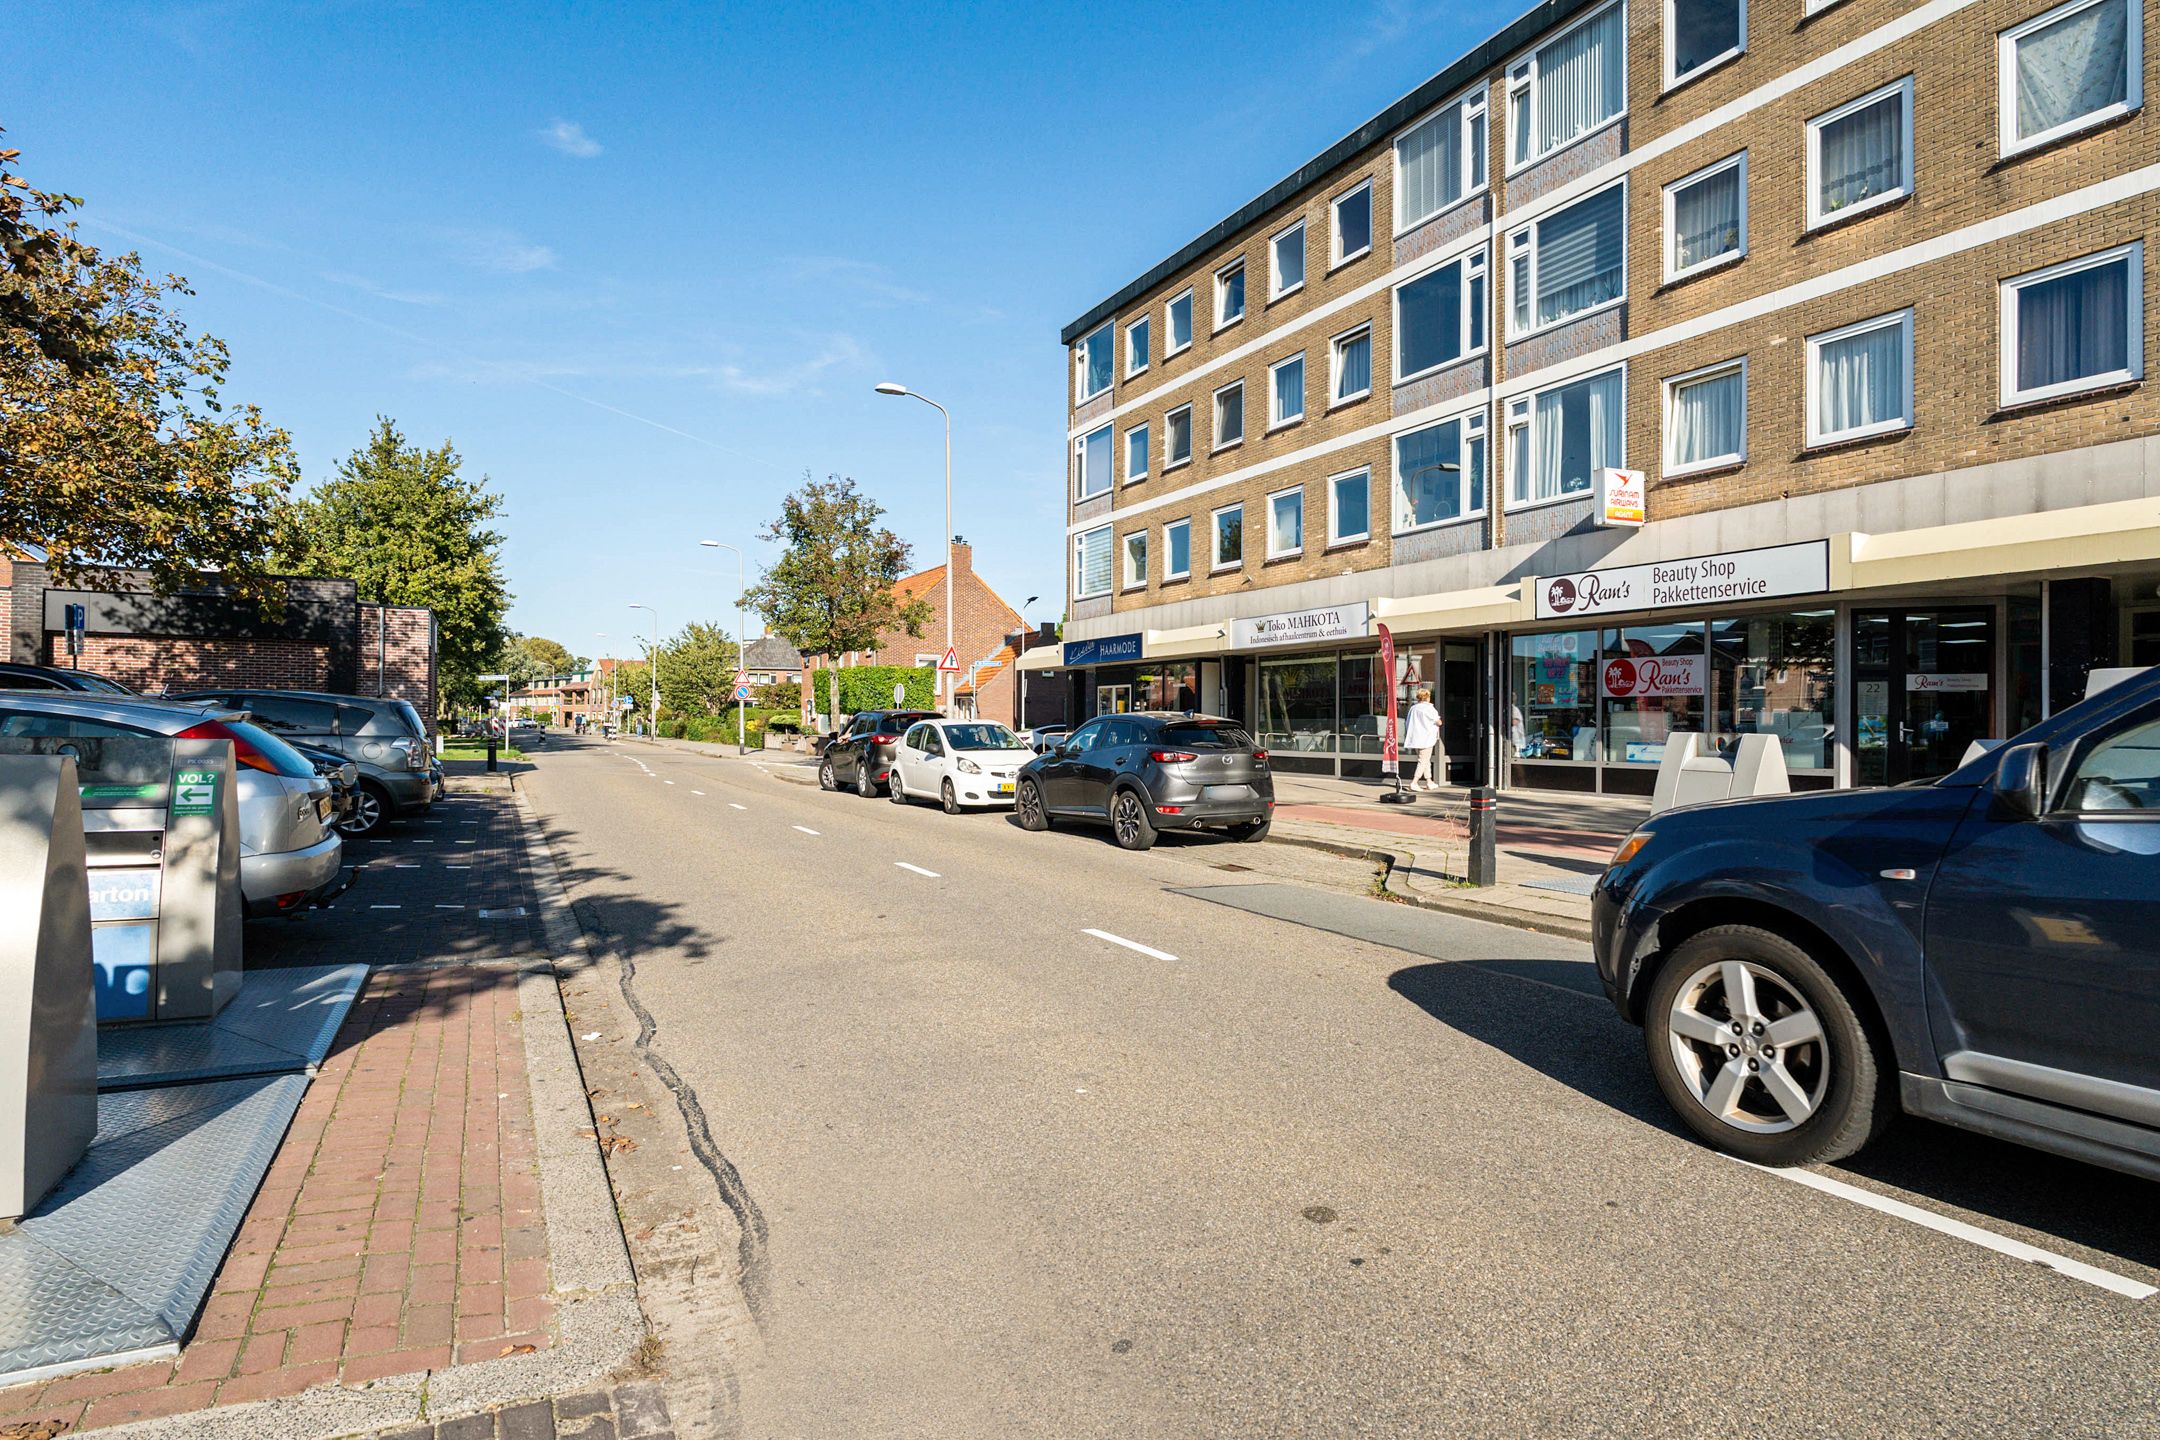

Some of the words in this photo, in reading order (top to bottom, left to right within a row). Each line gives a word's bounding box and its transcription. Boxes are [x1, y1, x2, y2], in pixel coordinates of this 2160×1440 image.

[1609, 490, 1640, 499] SURINAM
[1610, 498, 1639, 508] AIRWAYS
[1653, 565, 1698, 584] Beauty
[1701, 559, 1736, 580] Shop
[1578, 574, 1631, 611] Ram's
[1653, 577, 1767, 605] Pakkettenservice
[77, 608, 84, 627] P
[1267, 619, 1286, 632] Toko
[1287, 611, 1341, 630] MAHKOTA
[1250, 634, 1278, 644] Indonesisch
[1318, 629, 1325, 637] &
[1100, 640, 1136, 657] HAARMODE
[1680, 657, 1694, 667] Shop
[1639, 660, 1691, 694] Ram's
[1866, 683, 1881, 693] 22
[178, 773, 215, 784] VOL?
[89, 886, 150, 904] arton
